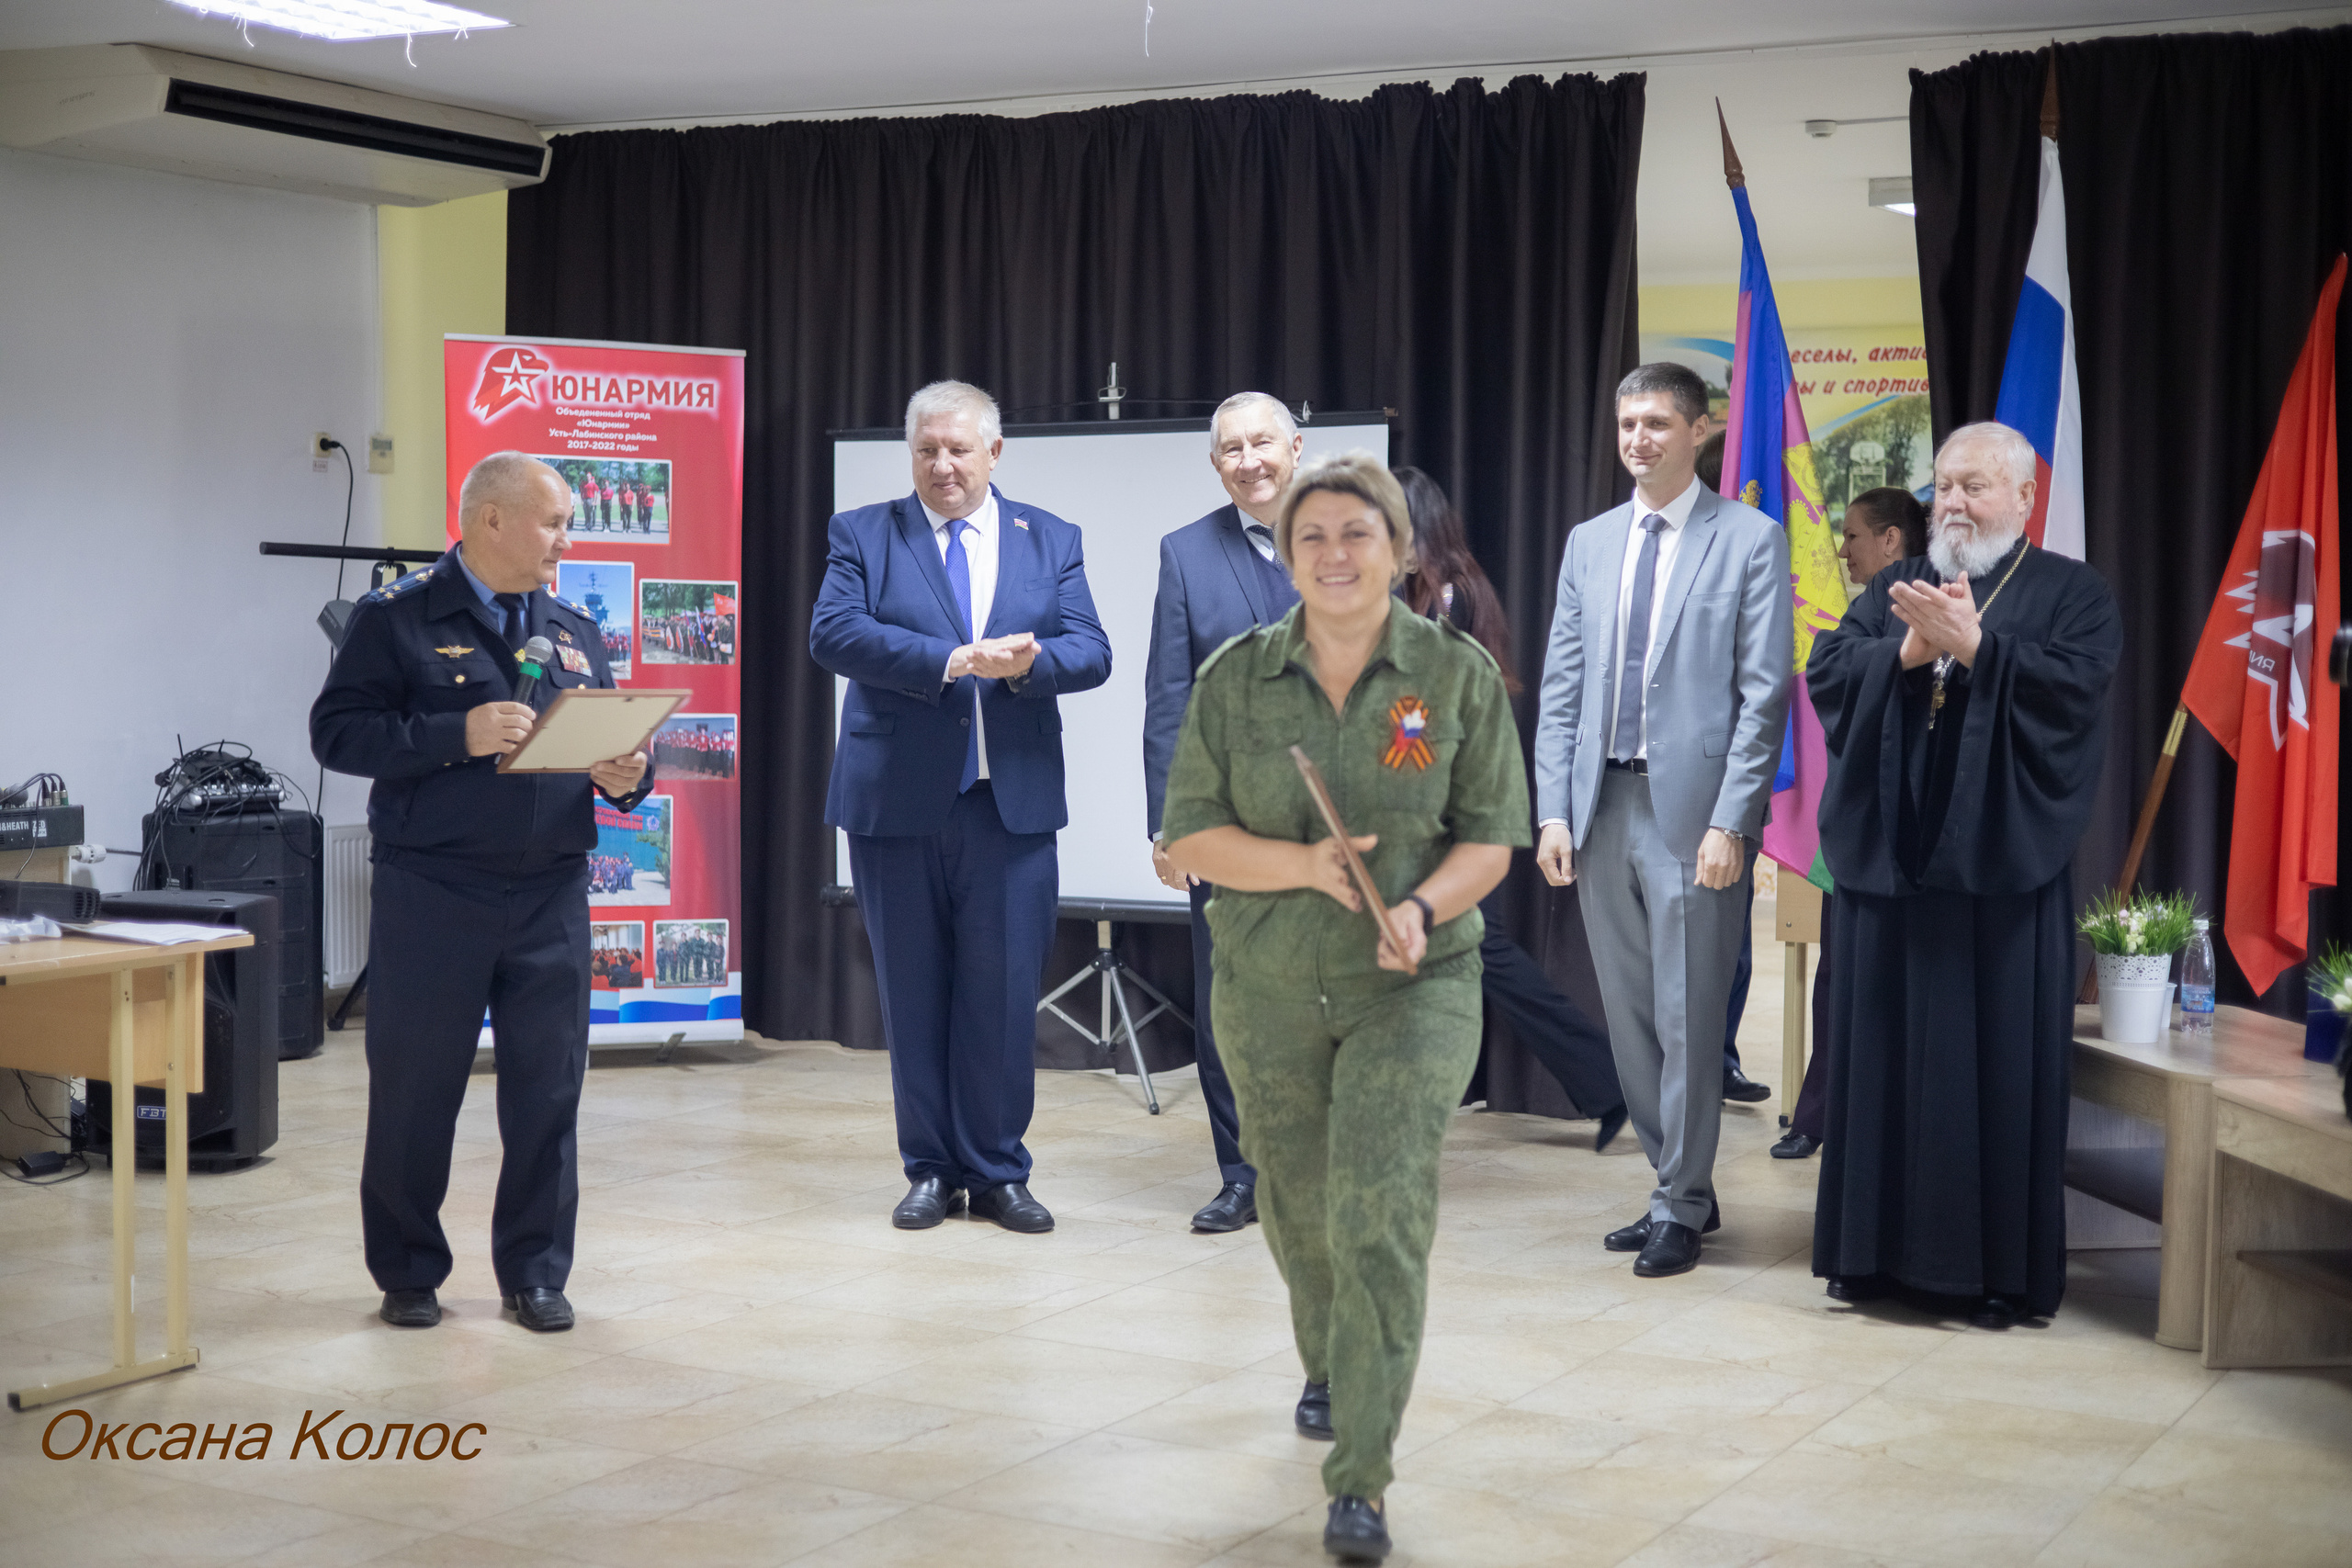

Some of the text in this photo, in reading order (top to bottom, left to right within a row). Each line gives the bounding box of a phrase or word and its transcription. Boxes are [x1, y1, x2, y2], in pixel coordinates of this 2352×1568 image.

[1791, 348, 1858, 365] еселы,
[552, 375, 714, 408] ЮНАРМИЯ
[1823, 379, 1837, 395] и
[624, 412, 651, 421] отряд
[576, 418, 630, 430] «Юнармии»
[548, 428, 658, 442] Усть-Лабинского района
[567, 439, 639, 452] 2017-2022 годы
[2248, 649, 2276, 671] ИЯ
[140, 1107, 166, 1118] FBT
